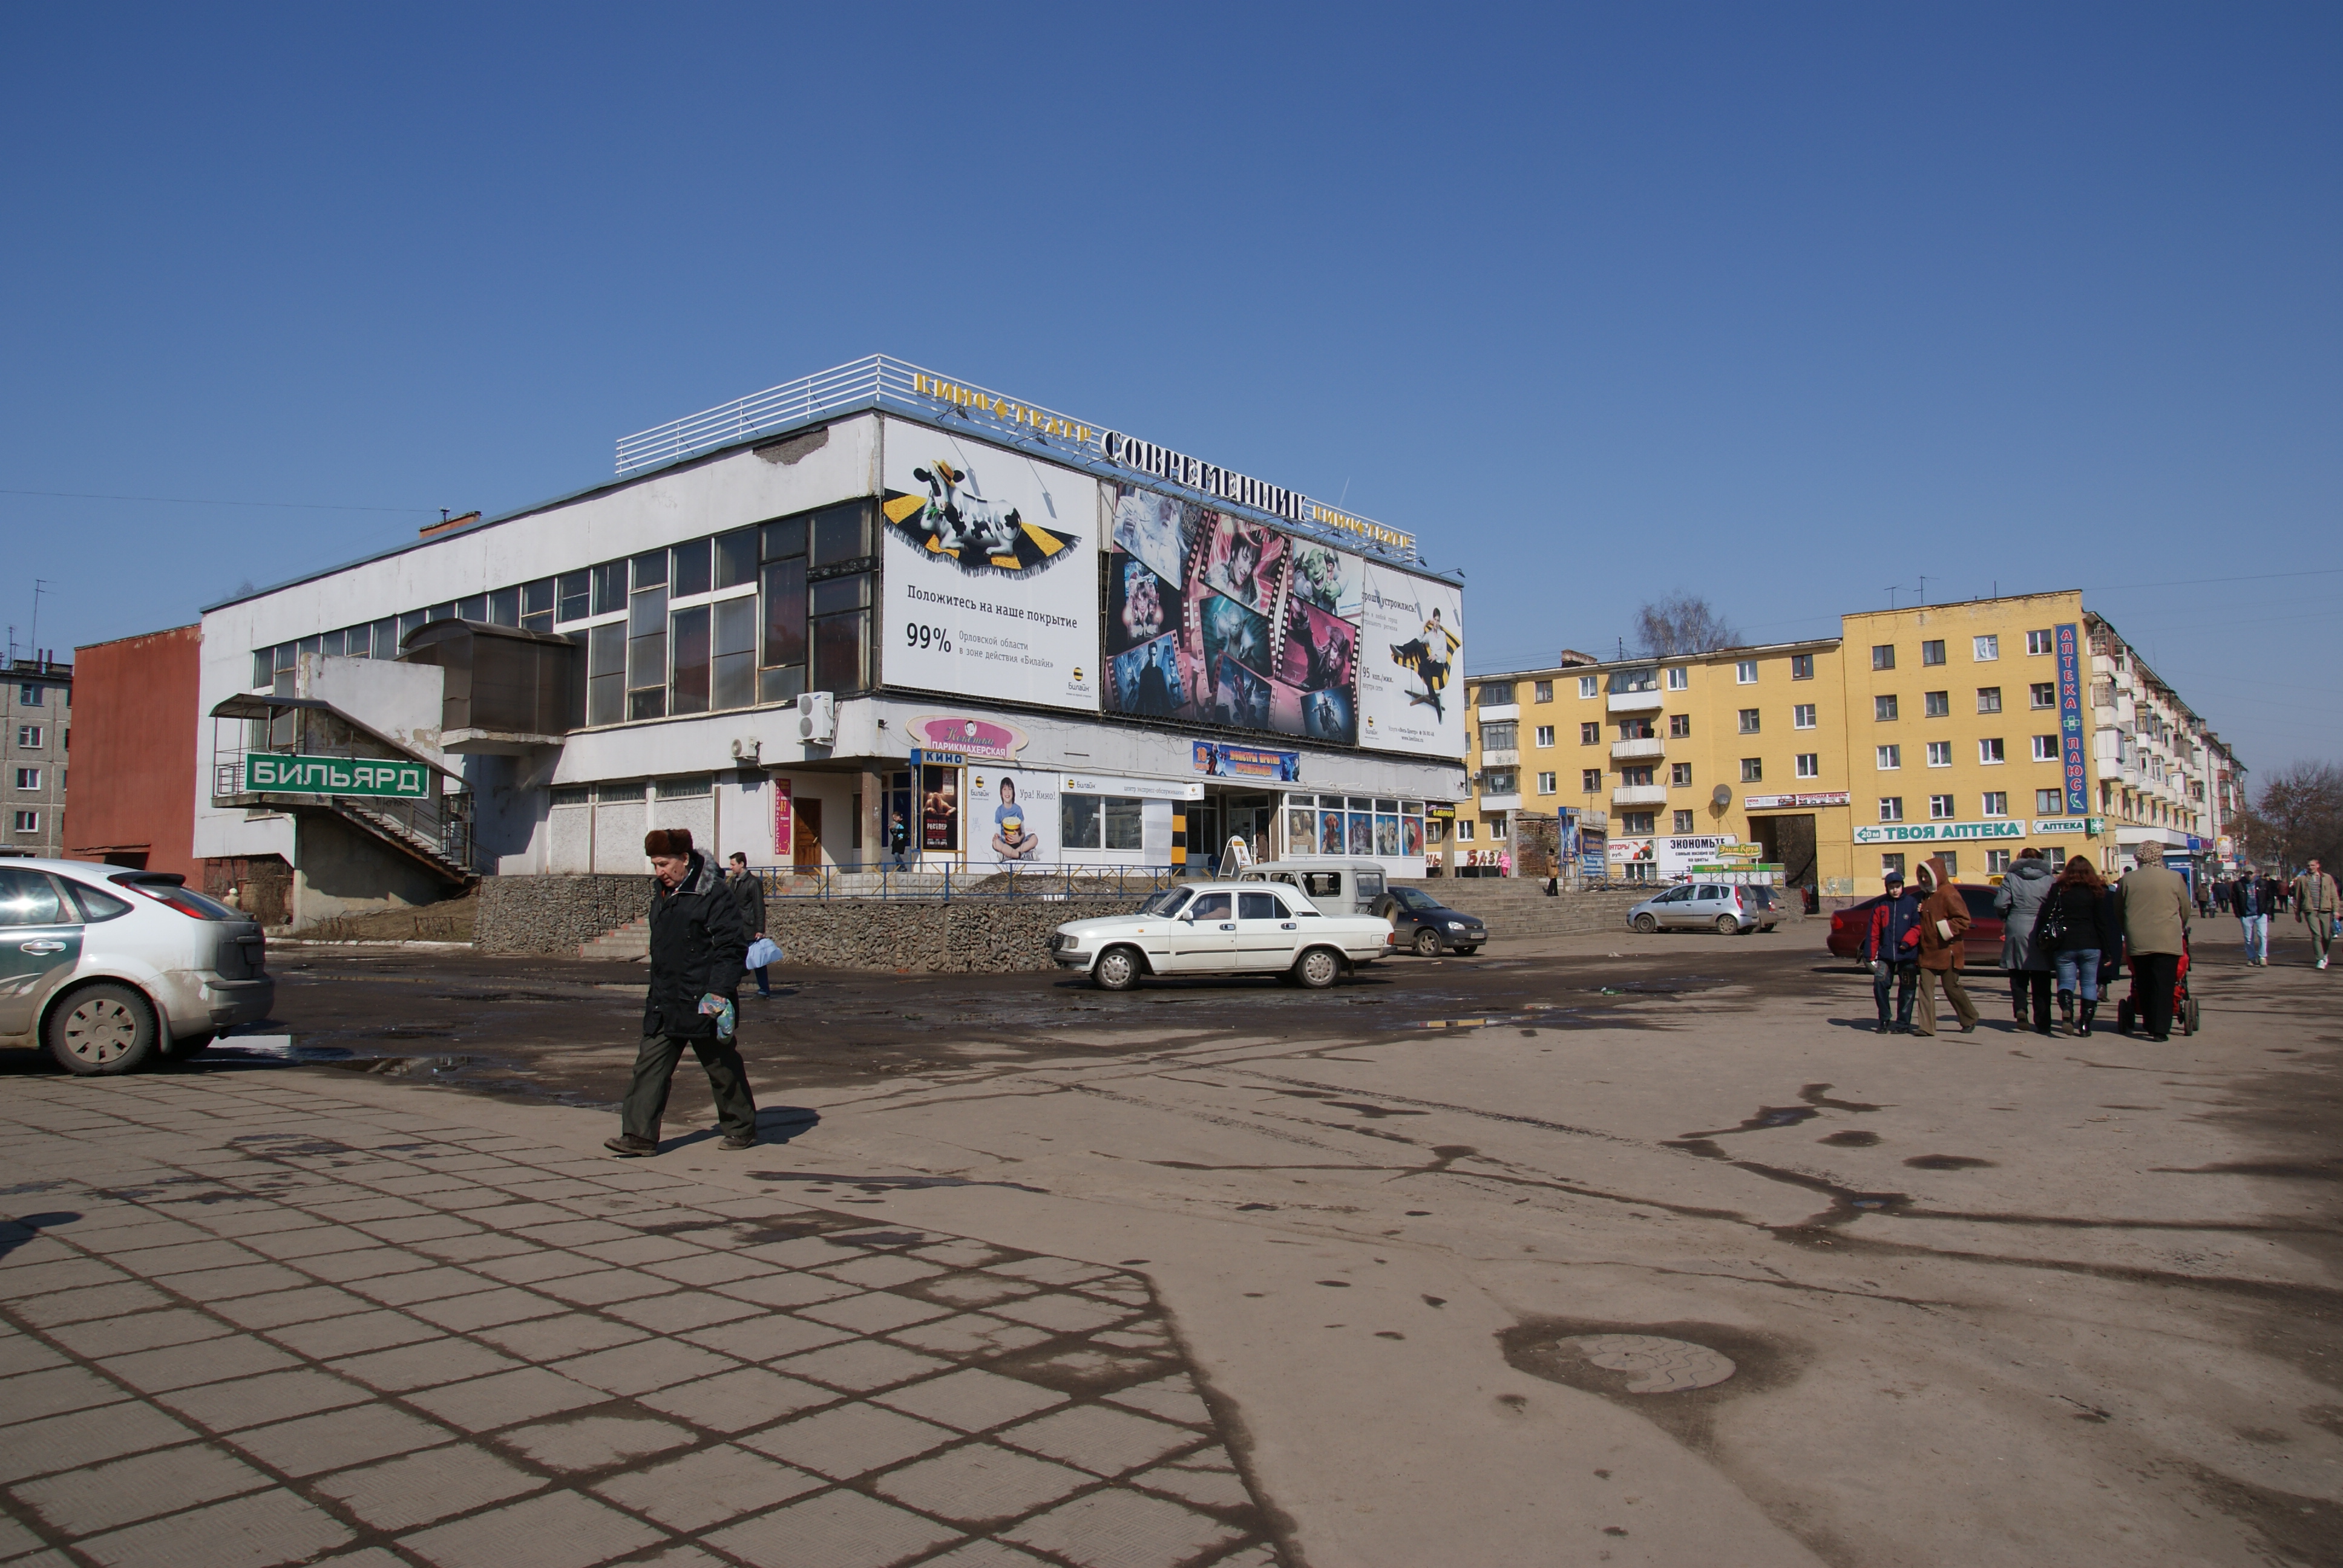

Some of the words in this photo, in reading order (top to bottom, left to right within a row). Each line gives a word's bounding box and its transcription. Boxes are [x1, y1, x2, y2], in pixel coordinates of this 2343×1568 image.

[1100, 430, 1308, 522] СОВРЕМЕННИК
[907, 584, 977, 610] Положитесь
[979, 602, 993, 613] на
[995, 603, 1024, 619] наше
[1027, 610, 1078, 629] покрытие
[906, 622, 952, 653] 99%
[958, 630, 998, 646] Орловской
[1000, 634, 1029, 651] области
[966, 648, 983, 658] зоне
[985, 652, 1018, 664] действия
[1020, 656, 1054, 668] «Билайн»
[1363, 666, 1370, 678] 95
[2060, 629, 2077, 710] АПТЕКА
[1067, 682, 1090, 692] Билайн
[926, 752, 962, 764] КИНО
[932, 741, 1006, 757] ПАРИКМАХЕРСКАЯ
[1196, 746, 1207, 762] 19
[2067, 736, 2084, 792] ПЛЮС
[254, 761, 420, 792] БИЛЬЯРД
[1020, 789, 1034, 800] Ура!
[1036, 790, 1055, 800] Кино!
[1884, 825, 1935, 840] ТВОЯ
[1941, 822, 2020, 838] АПТЕКА
[2042, 821, 2084, 831] АПТЕКА
